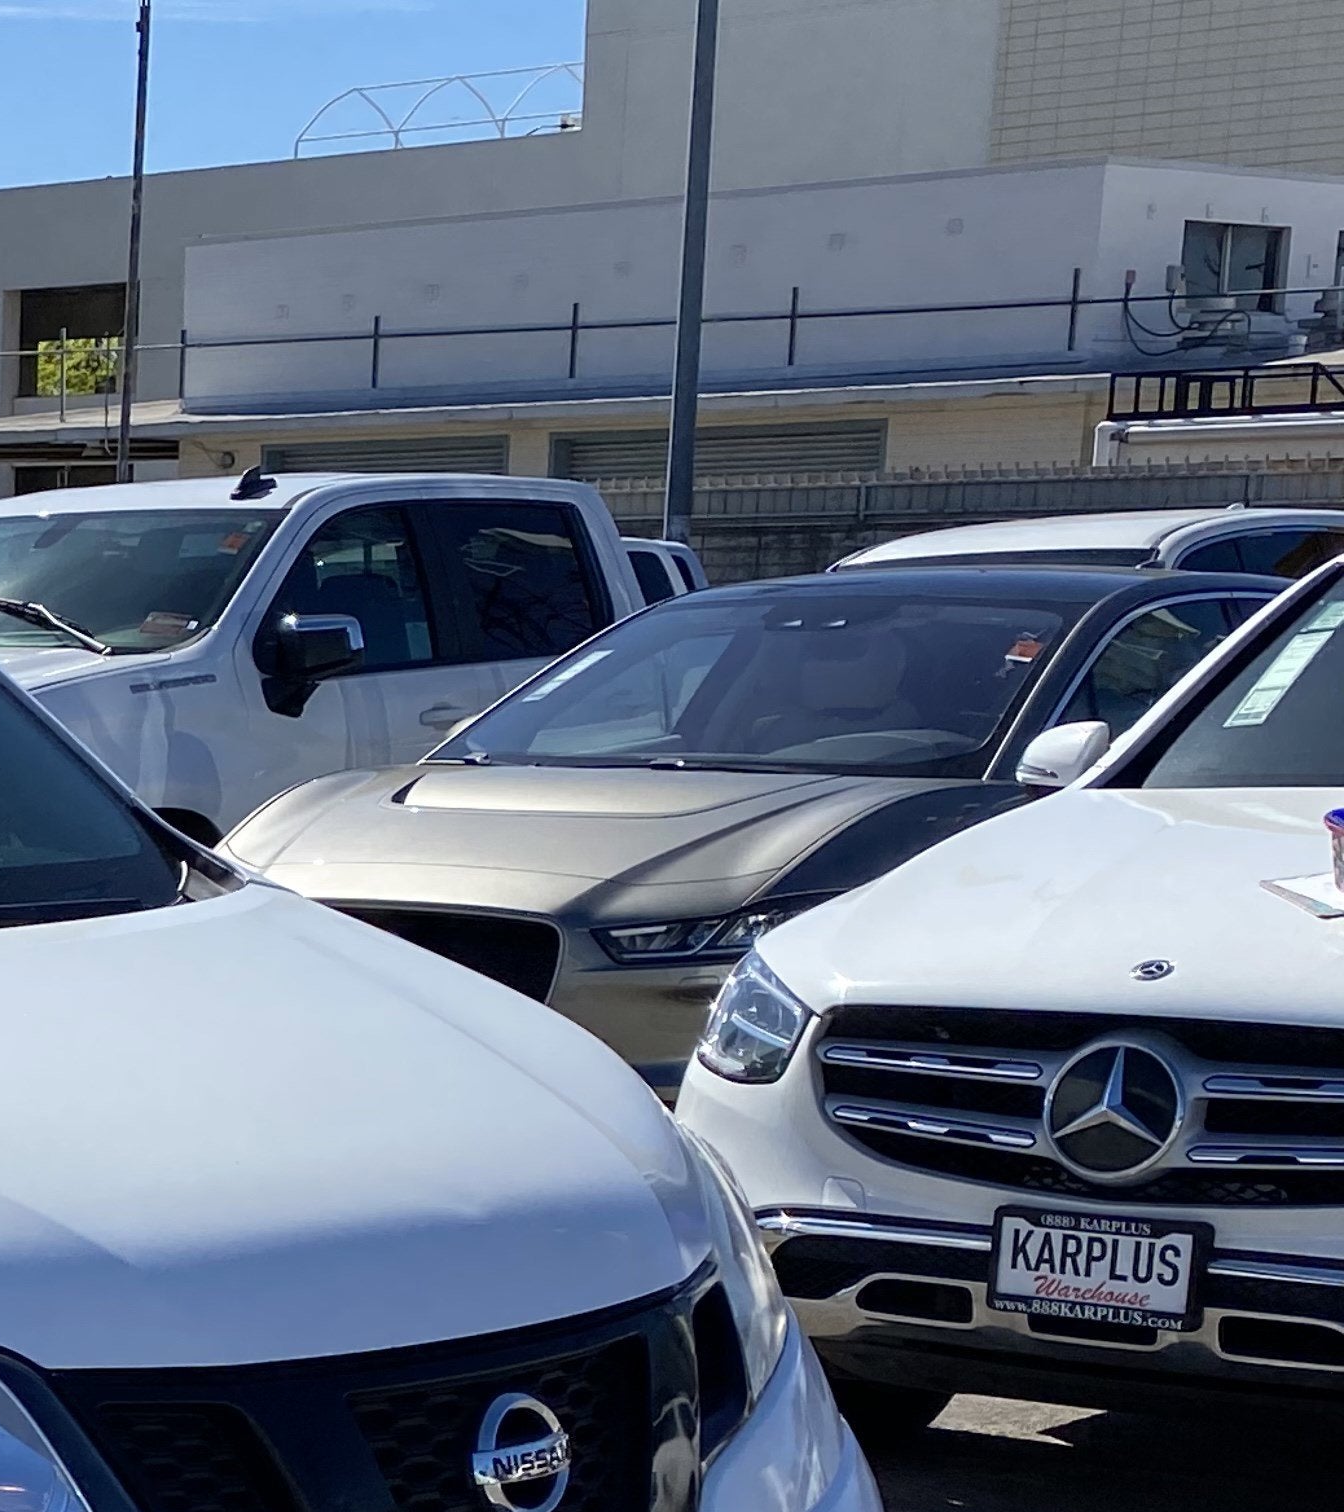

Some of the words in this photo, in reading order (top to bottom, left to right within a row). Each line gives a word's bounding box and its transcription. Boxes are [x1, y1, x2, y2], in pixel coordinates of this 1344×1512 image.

[1041, 1214, 1076, 1228] (888)
[1079, 1217, 1151, 1235] KARPLUS
[1010, 1228, 1182, 1287] KARPLUS
[1033, 1275, 1151, 1307] Warehouse
